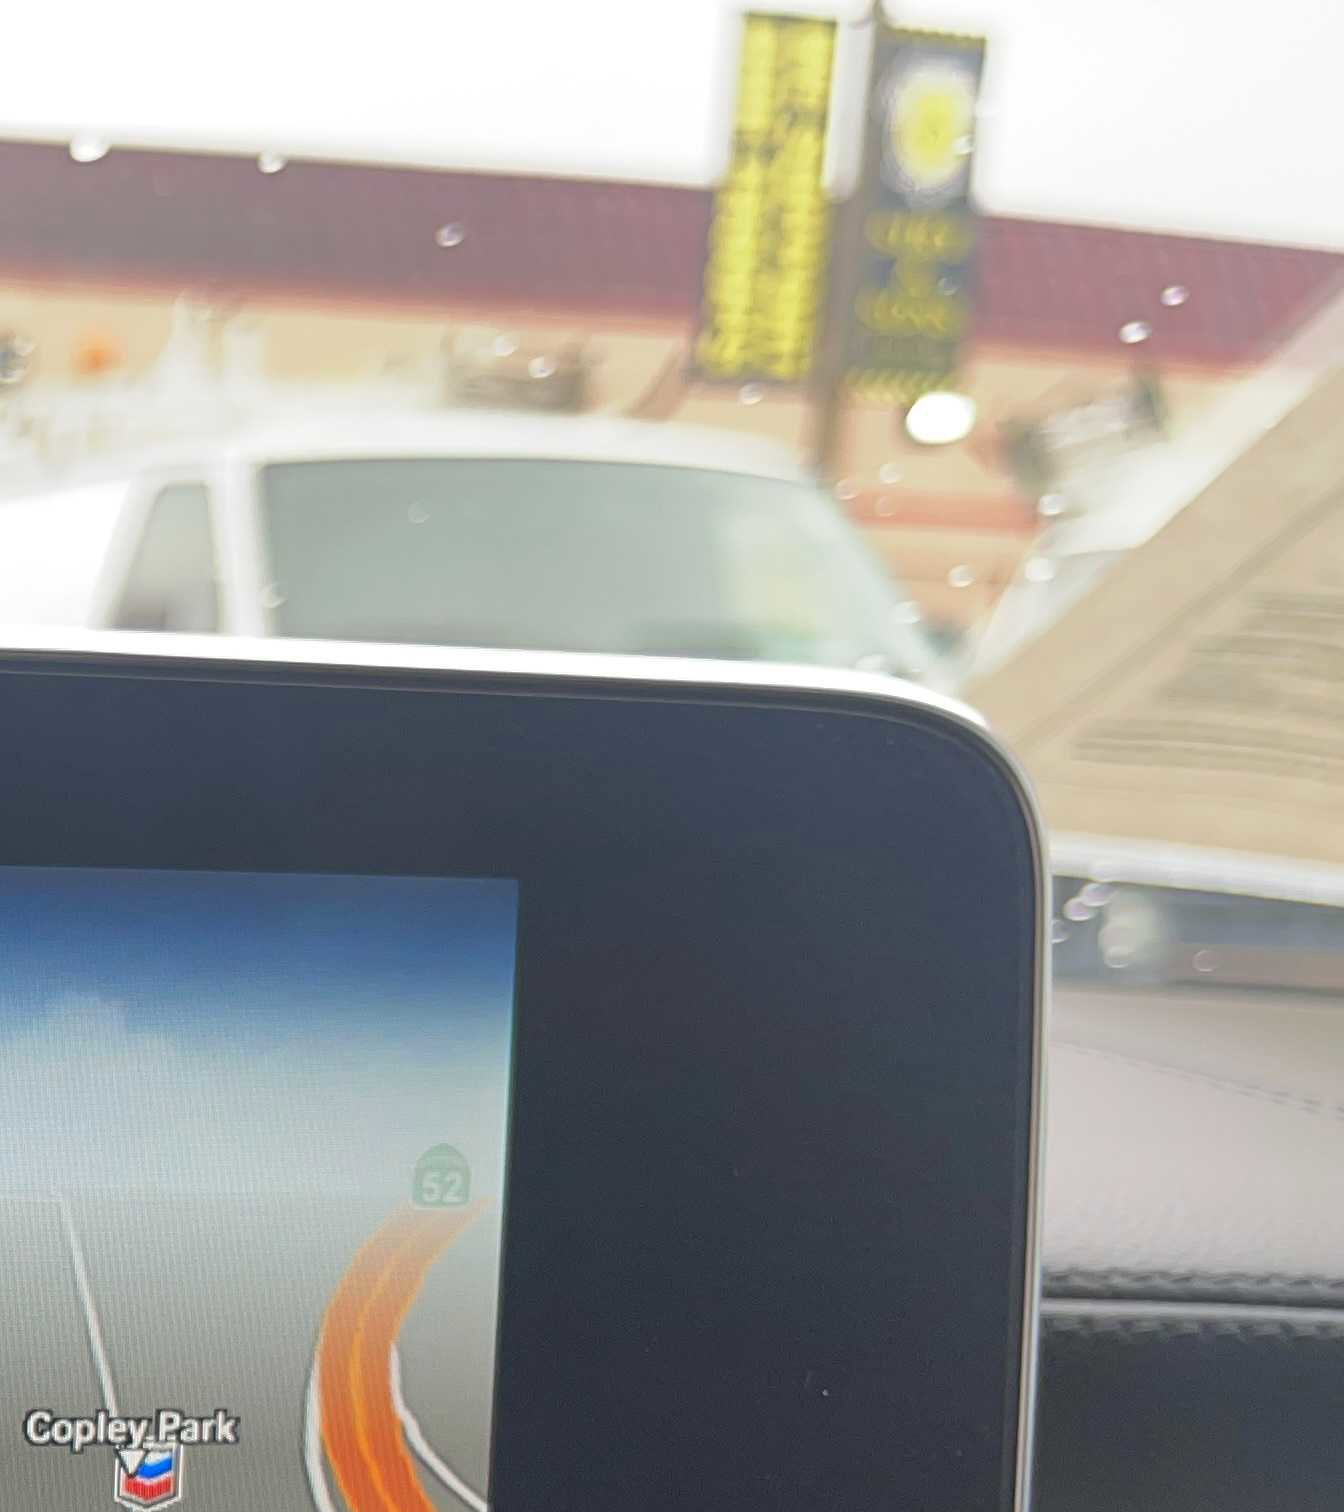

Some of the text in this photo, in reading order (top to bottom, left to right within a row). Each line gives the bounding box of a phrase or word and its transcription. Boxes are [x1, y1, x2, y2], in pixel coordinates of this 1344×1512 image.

[421, 1169, 466, 1204] 52
[26, 1410, 238, 1449] Copley Park
